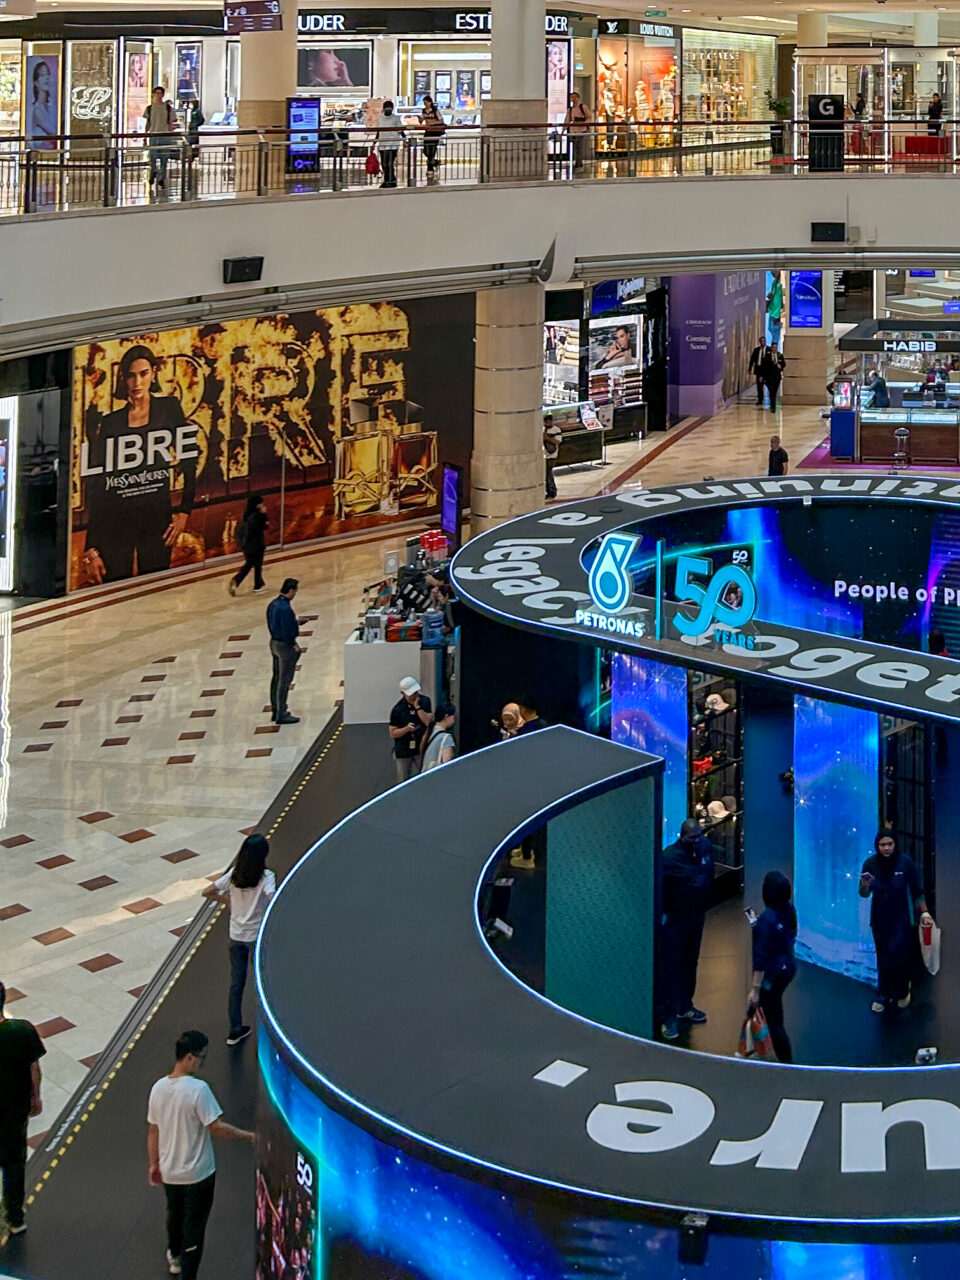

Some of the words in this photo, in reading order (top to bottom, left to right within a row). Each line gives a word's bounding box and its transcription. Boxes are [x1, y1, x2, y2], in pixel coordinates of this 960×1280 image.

[297, 14, 345, 31] UDER
[640, 23, 654, 35] LOUIS
[819, 98, 835, 116] G
[686, 334, 712, 343] Coming
[884, 341, 937, 352] HABIB
[80, 424, 199, 477] LIBRE
[538, 512, 603, 526] a
[673, 555, 757, 637] 50
[834, 580, 909, 602] People
[916, 586, 937, 602] of
[575, 609, 644, 639] PETRONAS
[713, 628, 756, 650] YEARS
[297, 1151, 313, 1187] 50
